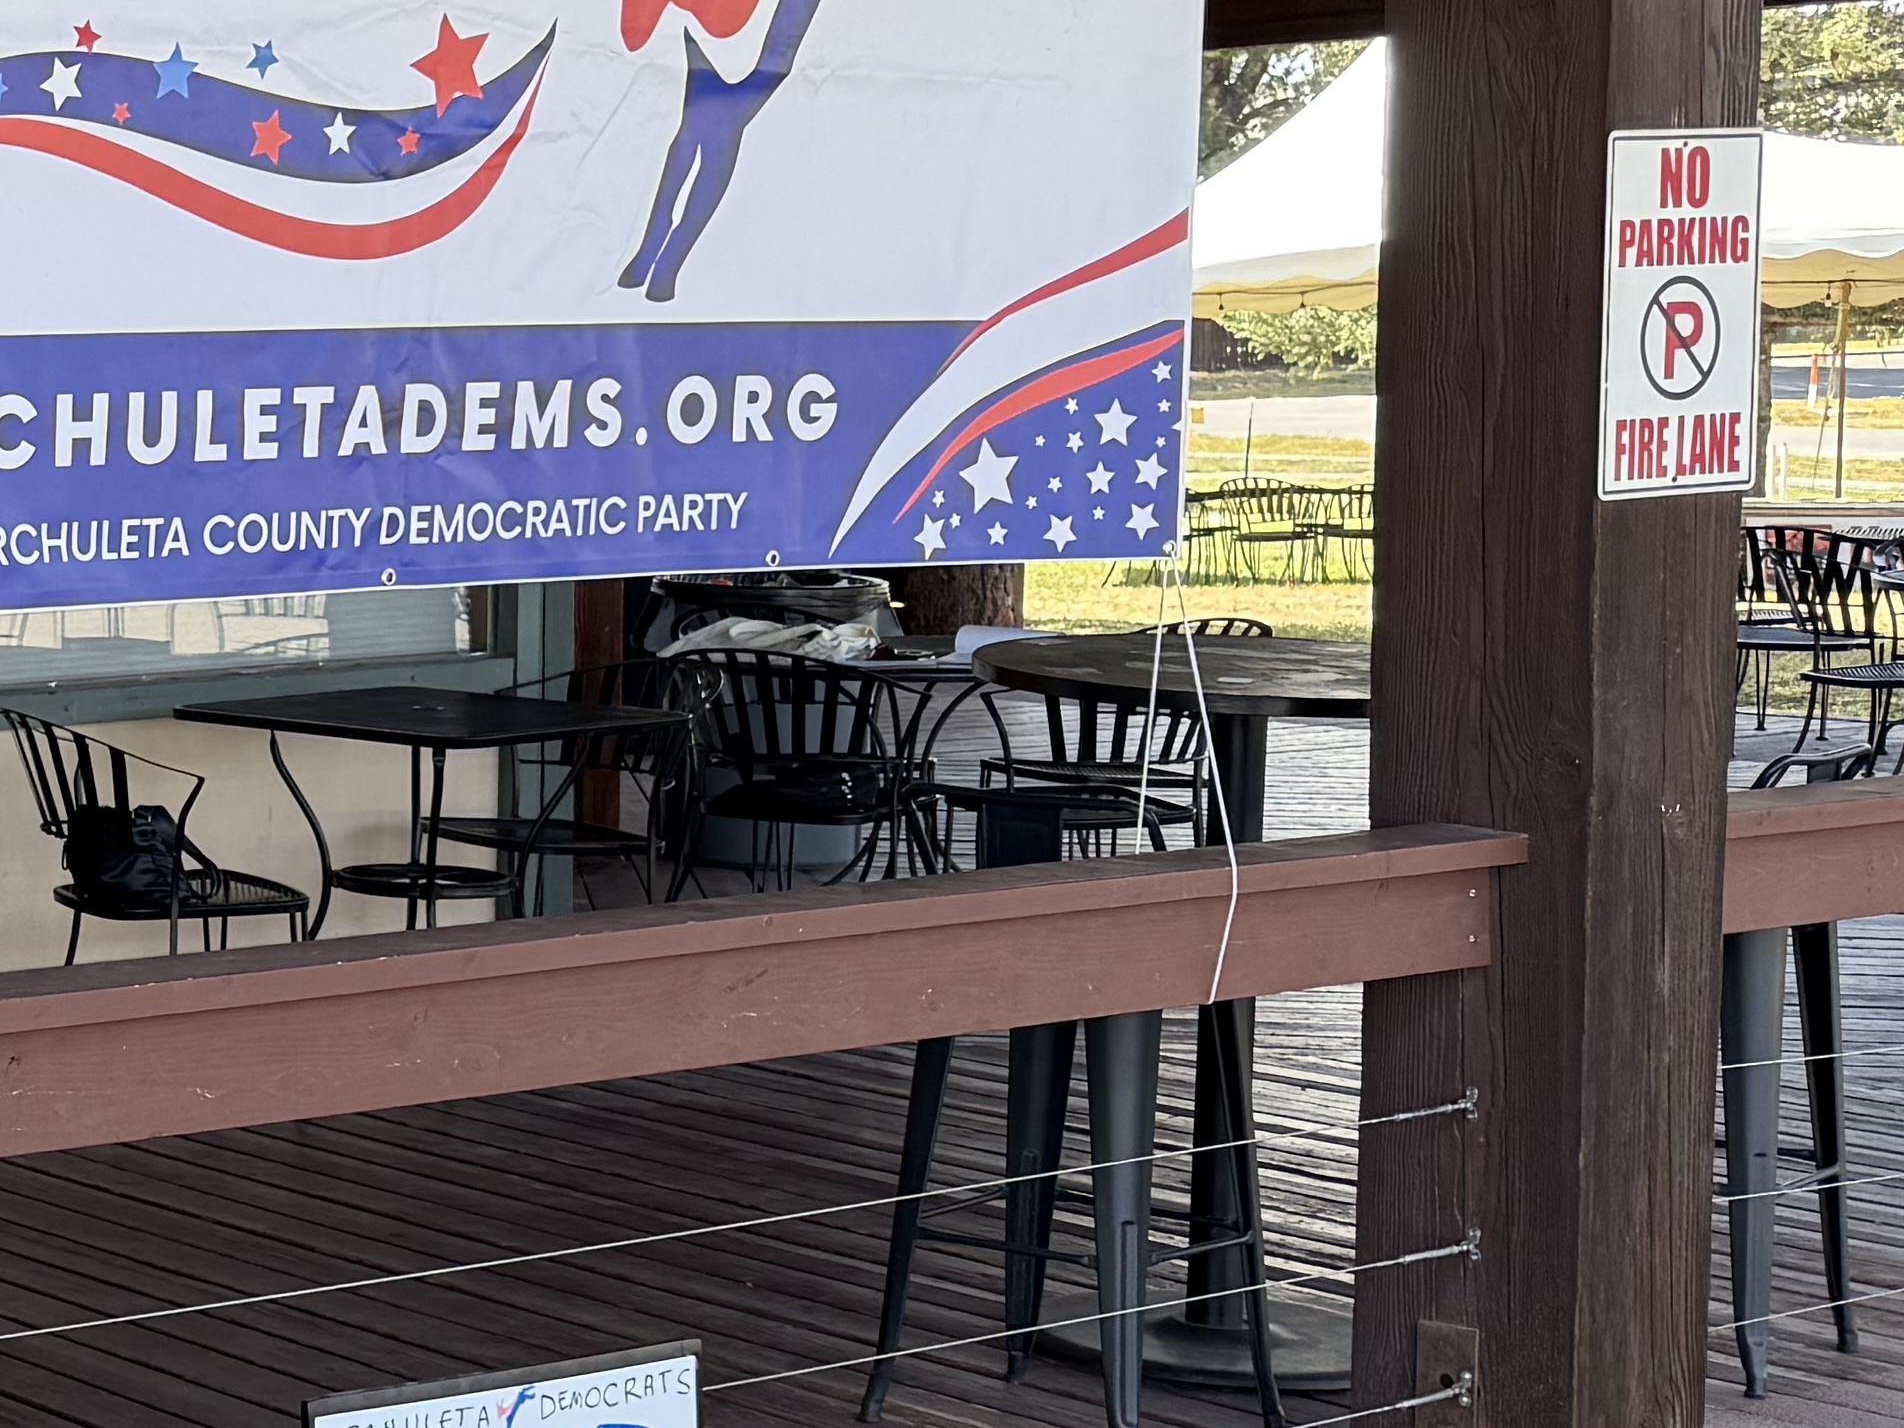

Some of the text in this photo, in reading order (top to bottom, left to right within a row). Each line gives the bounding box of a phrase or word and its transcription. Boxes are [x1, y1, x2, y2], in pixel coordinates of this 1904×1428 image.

[1659, 146, 1711, 210] NO
[1618, 215, 1750, 268] PARKING
[1614, 412, 1741, 482] FIRE LANE
[202, 507, 372, 556] COUNTY
[379, 495, 628, 546] DEMOCRATIC
[637, 491, 749, 533] PARTY
[540, 1368, 691, 1420] DEMOCRATS
